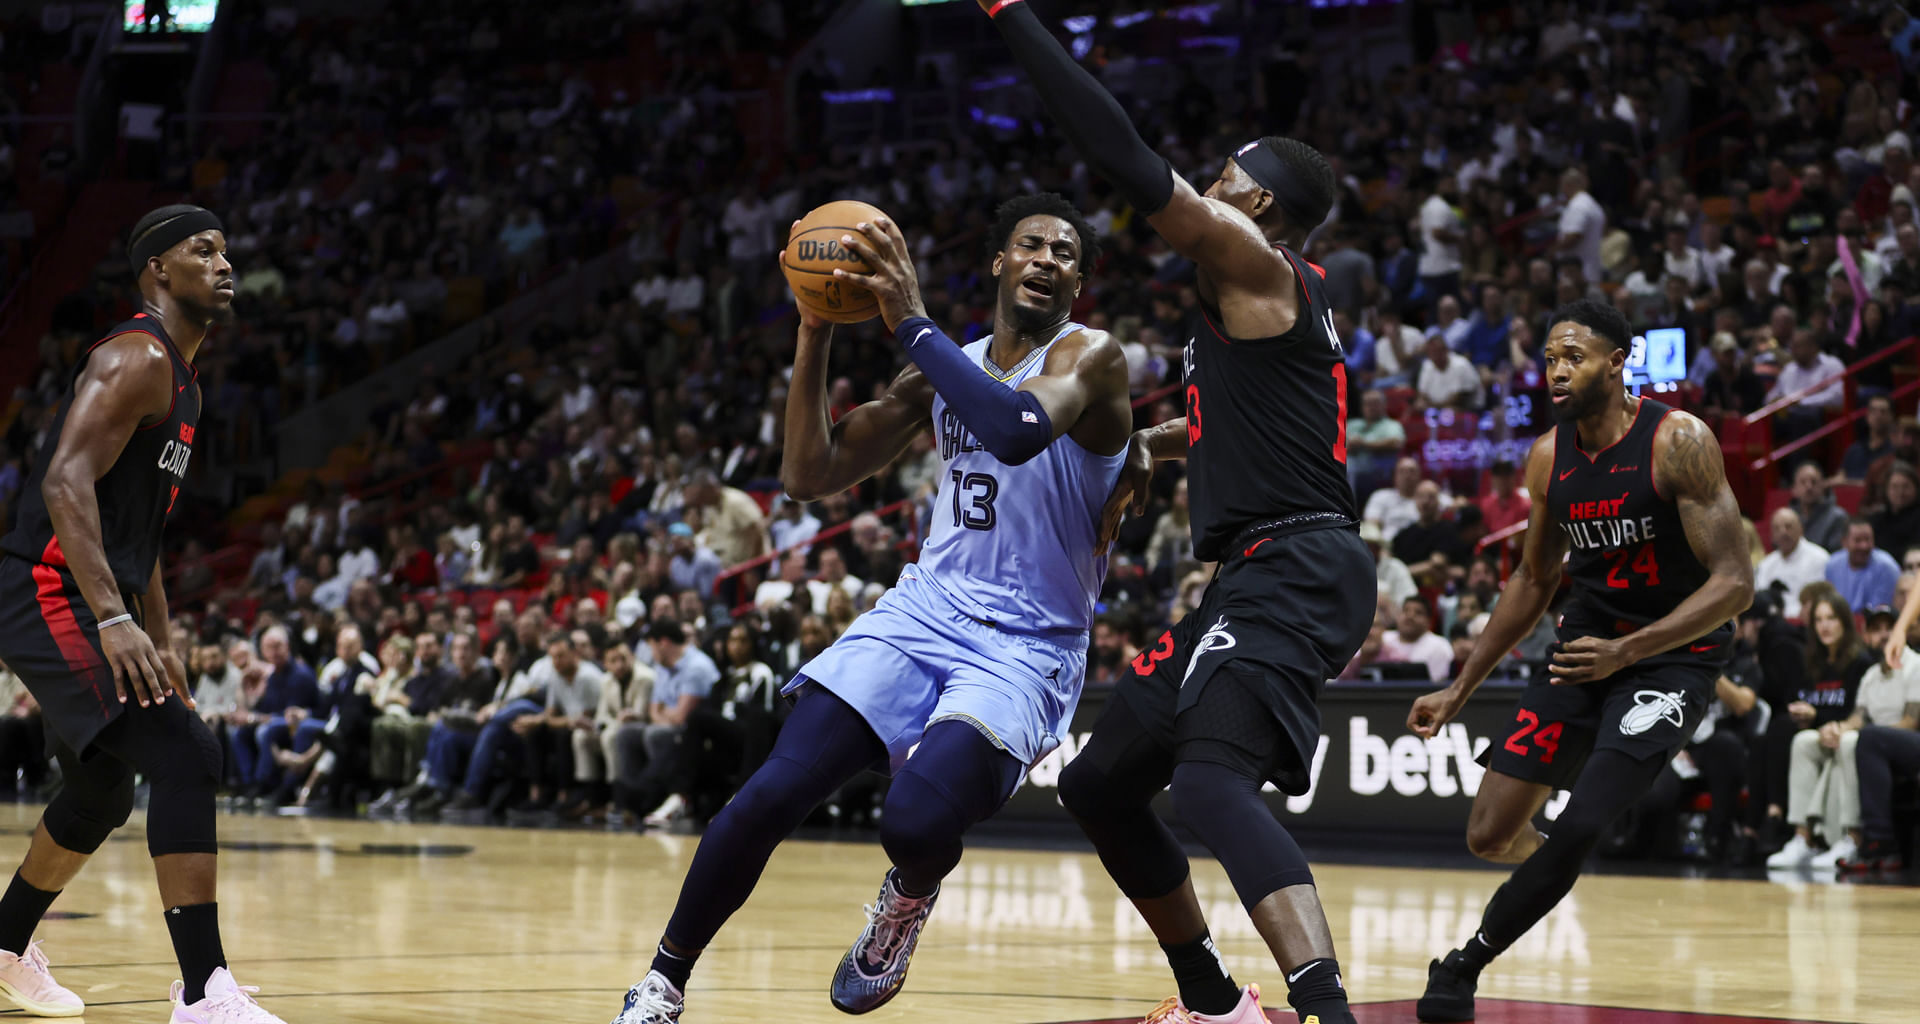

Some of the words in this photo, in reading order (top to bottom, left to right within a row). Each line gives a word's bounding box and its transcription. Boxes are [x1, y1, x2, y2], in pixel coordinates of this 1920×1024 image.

[798, 240, 862, 263] Wilso
[952, 469, 999, 531] 13
[1569, 491, 1630, 520] HEAT
[1603, 542, 1661, 589] 24
[1504, 708, 1564, 764] 24
